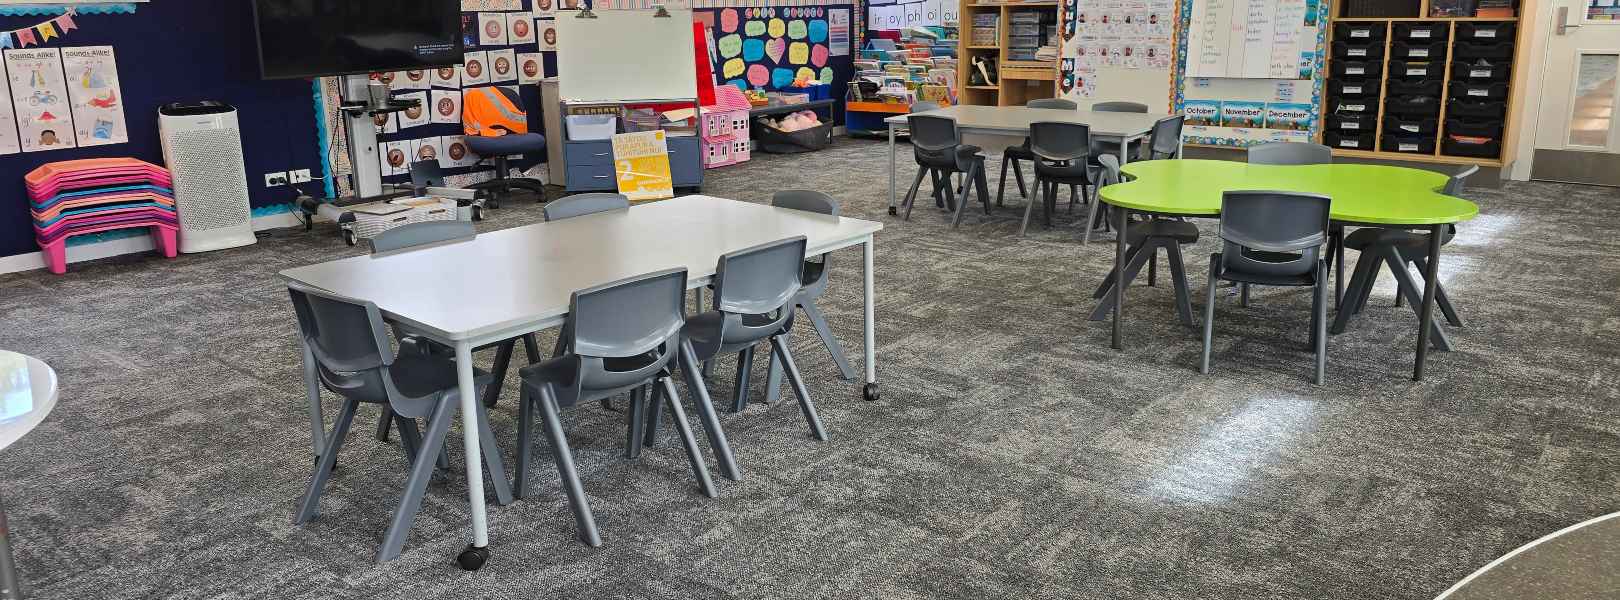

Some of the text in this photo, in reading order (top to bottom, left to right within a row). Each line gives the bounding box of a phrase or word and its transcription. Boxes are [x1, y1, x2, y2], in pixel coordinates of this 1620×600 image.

[889, 15, 901, 26] oy
[907, 9, 920, 25] ph
[927, 9, 937, 21] oi
[1186, 107, 1216, 115] October
[1225, 108, 1260, 116] November
[1268, 110, 1307, 118] December
